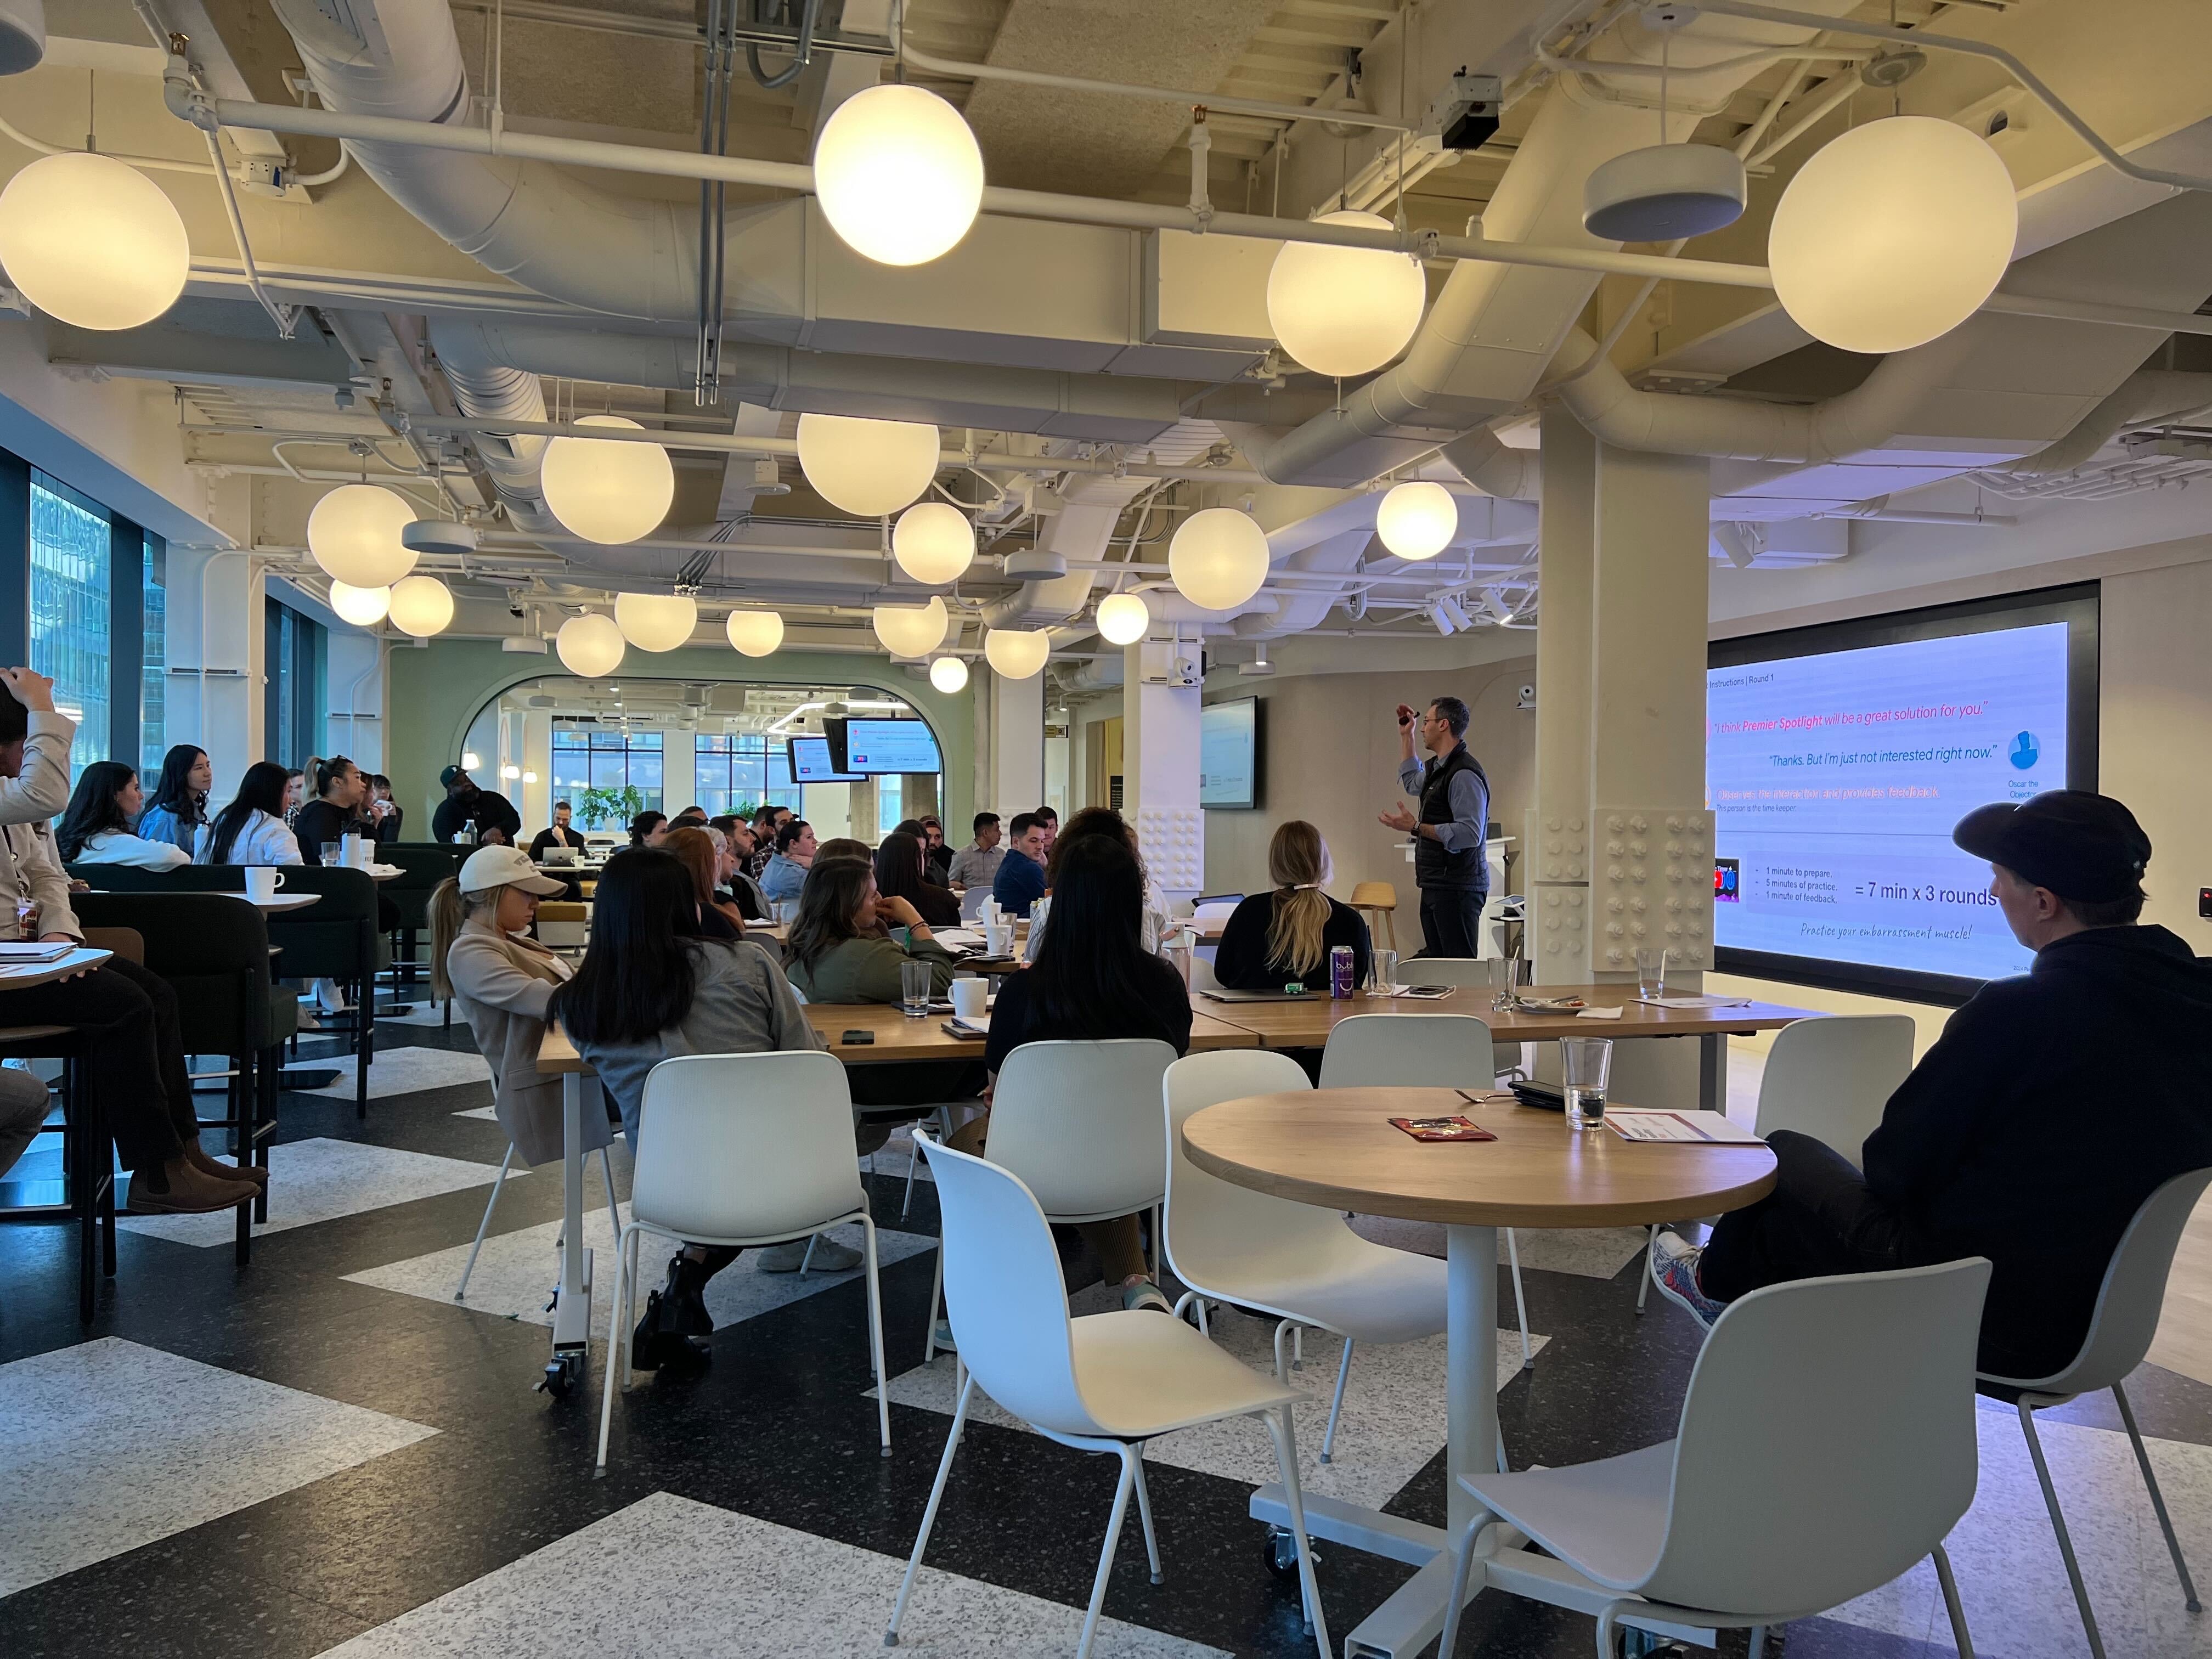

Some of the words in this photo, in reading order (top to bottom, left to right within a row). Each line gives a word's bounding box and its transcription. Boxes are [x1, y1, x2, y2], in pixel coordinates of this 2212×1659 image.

[1709, 678, 1744, 689] Instructions
[1749, 674, 1769, 684] Round
[1722, 721, 1741, 733] think
[1743, 719, 1778, 731] Premier
[1780, 715, 1822, 732] Spotlight
[1825, 713, 1840, 725] will
[1842, 712, 1854, 724] be
[1857, 714, 1862, 723] a
[1865, 709, 1892, 726] great
[1894, 706, 1937, 720] solution
[1940, 704, 1957, 717] for
[1807, 753, 1822, 765] But
[1824, 752, 1838, 764] I'm
[1839, 752, 1858, 767] just
[1860, 751, 1877, 763] not
[1879, 748, 1933, 763] interested
[1936, 746, 1962, 763] right
[1716, 789, 1754, 800] Observes
[1757, 788, 1771, 799] the
[1773, 787, 1819, 799] interaction
[1822, 786, 1840, 799] and
[1842, 786, 1884, 802] provides
[1887, 785, 1940, 798] feedback.
[1771, 867, 1794, 876] minute
[1771, 879, 1797, 888] minutes
[1799, 881, 1806, 889] of
[1807, 882, 1838, 893] practice.
[1855, 886, 1864, 894] =
[1868, 882, 1876, 897] 7
[1881, 883, 1907, 899] min
[1912, 887, 1921, 900] x
[1926, 885, 1934, 901] 3
[1939, 888, 1997, 906] rounds
[1771, 891, 1793, 900] minute
[1795, 893, 1802, 901] of
[1803, 893, 1837, 904] feedback.
[1801, 922, 1836, 936] Practice
[1837, 927, 1857, 939] your
[1859, 923, 1932, 939] embarrassment
[1935, 923, 1973, 940] muscle!
